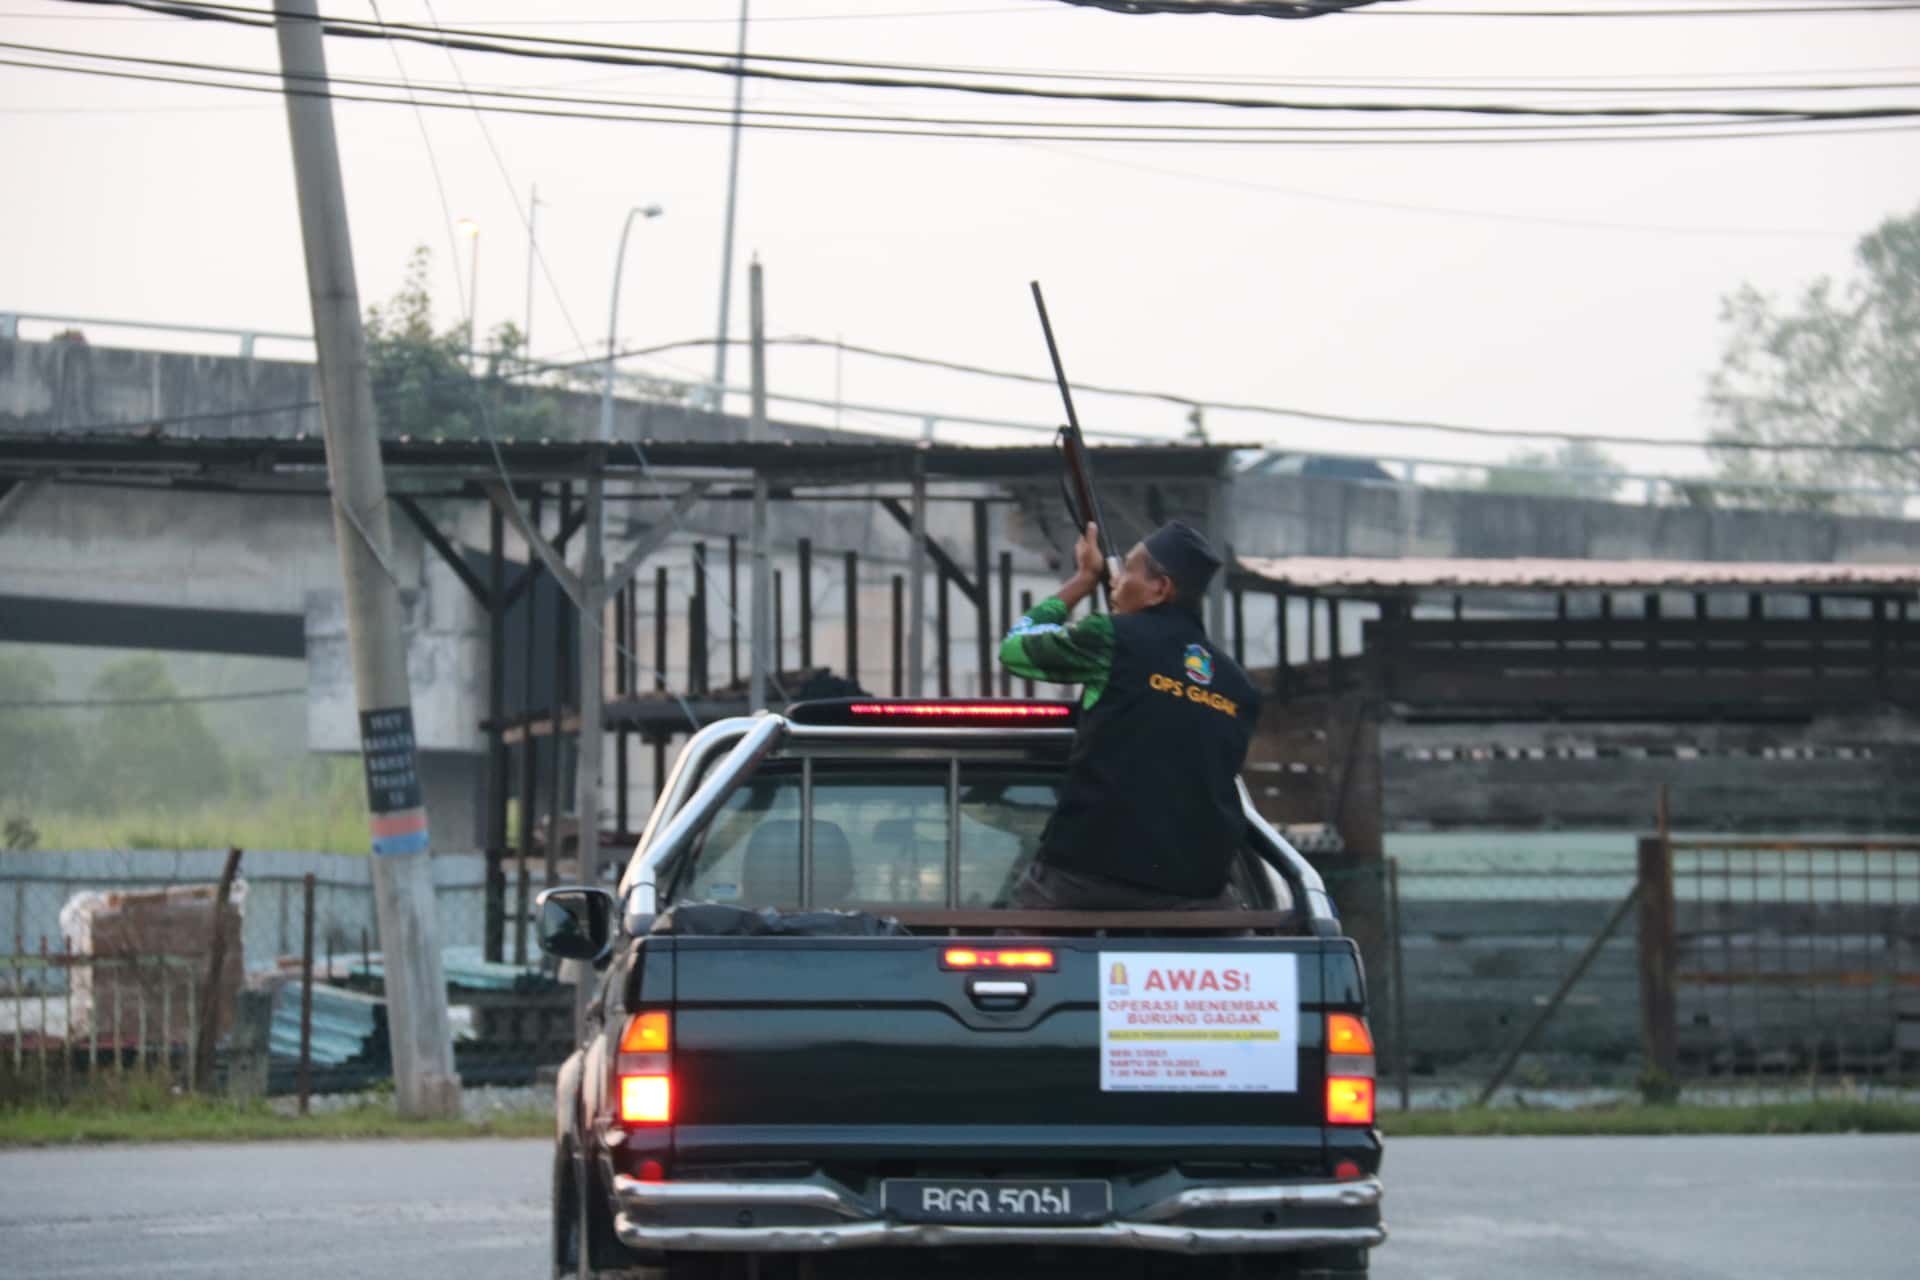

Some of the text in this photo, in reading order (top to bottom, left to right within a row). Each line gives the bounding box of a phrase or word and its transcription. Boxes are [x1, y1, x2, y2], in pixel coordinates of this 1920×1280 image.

[1149, 673, 1238, 718] OPS GAGAK
[1144, 968, 1251, 991] AWAS!
[1107, 1000, 1280, 1012] OPERASI MENEMBAK
[1127, 1013, 1262, 1024] BURUNG GAGAK
